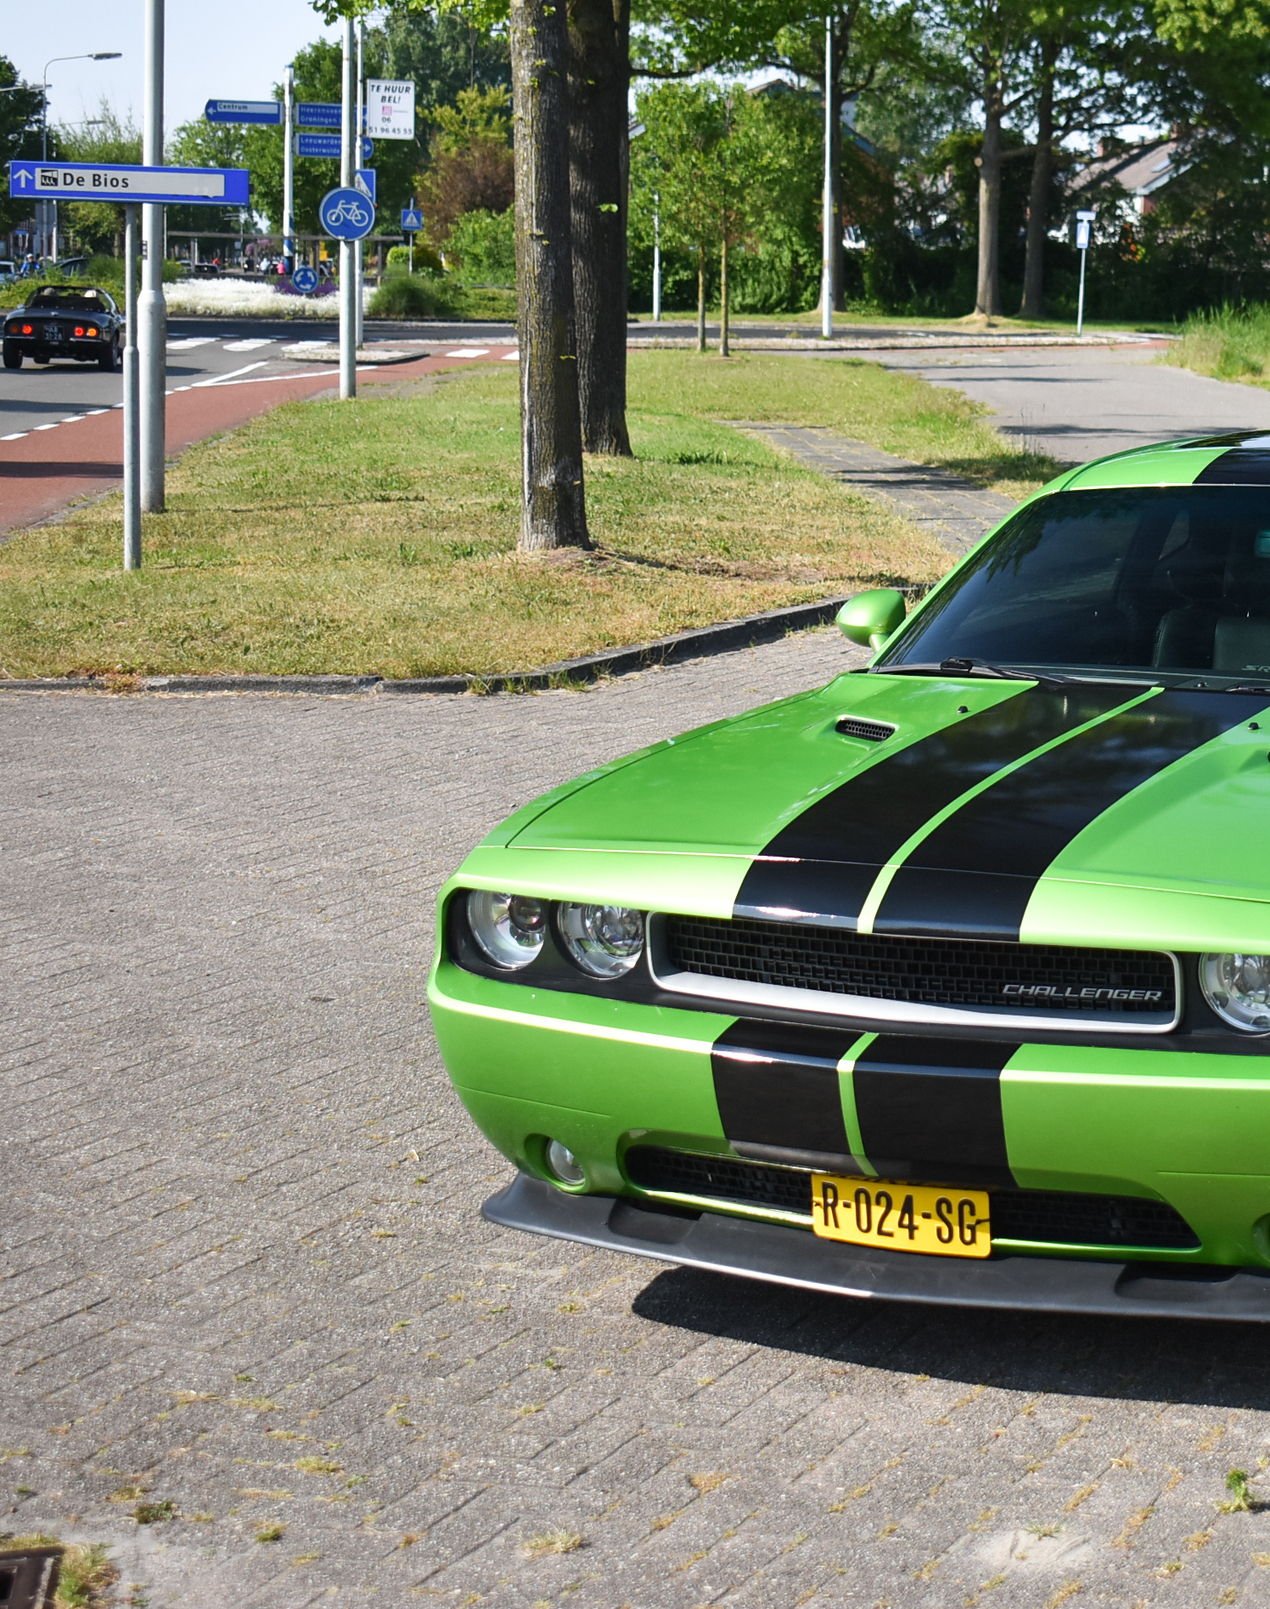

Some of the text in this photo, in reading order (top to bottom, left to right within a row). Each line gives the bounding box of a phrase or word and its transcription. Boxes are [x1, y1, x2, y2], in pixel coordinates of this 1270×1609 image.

[371, 84, 411, 94] TE HUUR
[381, 95, 401, 104] BEL!
[218, 103, 248, 111] Centrum
[300, 115, 338, 124] Groningen
[381, 116, 392, 124] 06
[63, 172, 129, 188] De Bios
[1002, 984, 1162, 1001] CHALLENGER
[821, 1180, 977, 1246] R-024-SG
